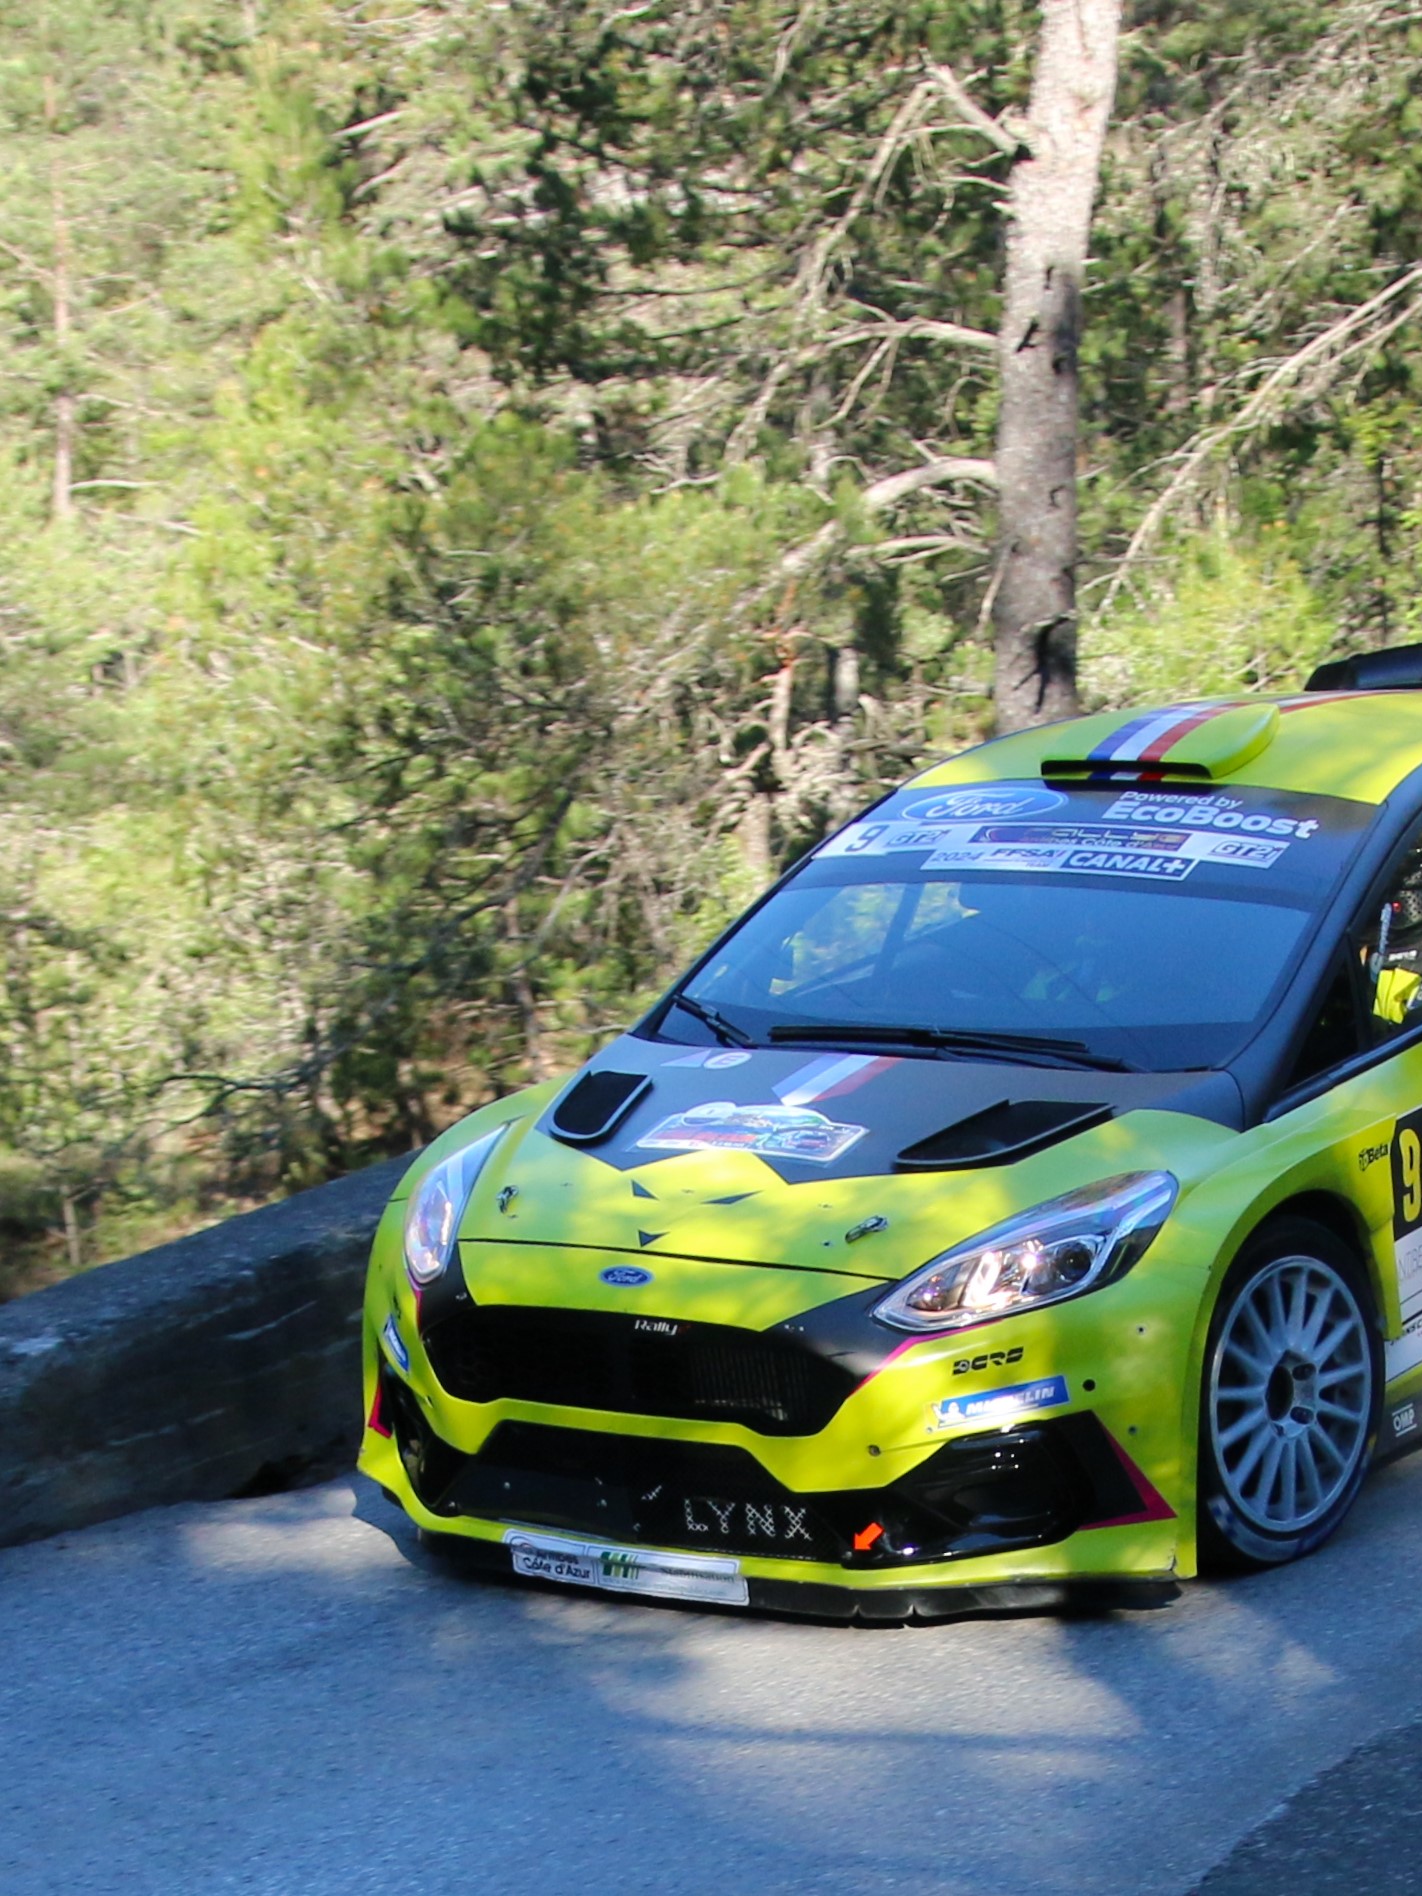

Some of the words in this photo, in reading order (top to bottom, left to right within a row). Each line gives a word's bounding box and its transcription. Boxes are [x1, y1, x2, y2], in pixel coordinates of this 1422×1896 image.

[925, 788, 1035, 819] Ford
[1120, 790, 1214, 806] Powered
[1215, 796, 1244, 810] by
[1101, 800, 1320, 840] EcoBoost
[844, 824, 890, 851] 9
[1067, 851, 1186, 874] CANAL+
[1366, 1143, 1389, 1165] Beta
[1398, 1128, 1422, 1223] 9
[607, 1268, 643, 1284] Ford
[965, 1385, 1056, 1416] MIELIN
[1393, 1408, 1416, 1432] OMP
[684, 1498, 813, 1543] LYNX
[521, 1556, 553, 1573] Côte
[555, 1562, 592, 1580] d'Azur
